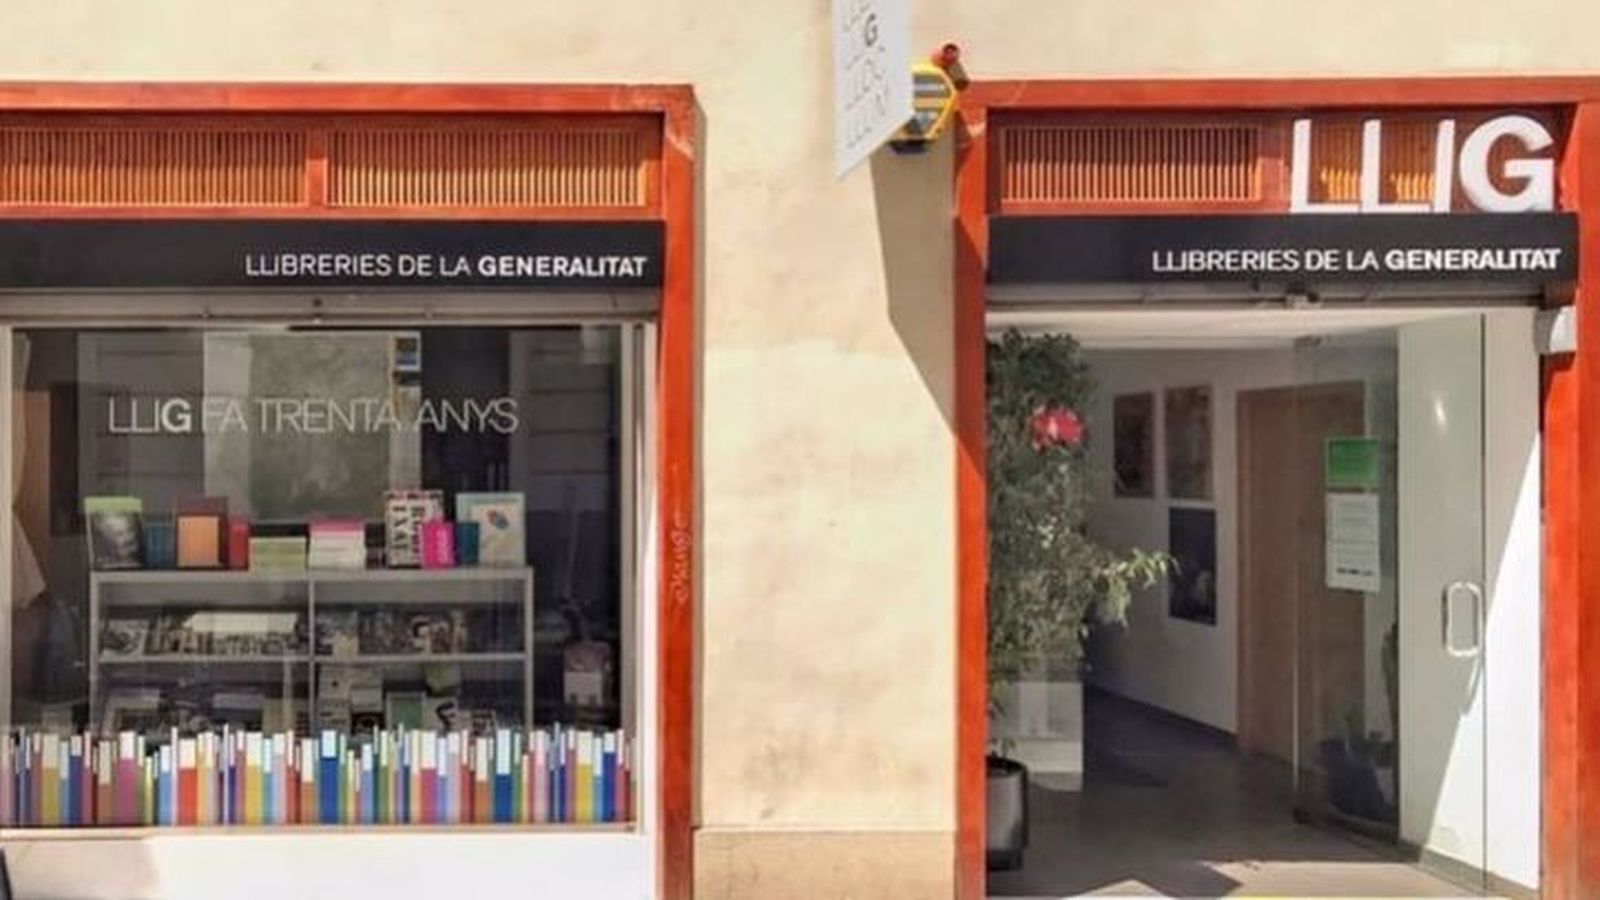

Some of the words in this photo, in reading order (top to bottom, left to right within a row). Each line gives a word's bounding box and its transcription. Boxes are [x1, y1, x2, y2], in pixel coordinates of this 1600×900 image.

[1289, 115, 1555, 213] LLIG
[245, 253, 393, 277] LLIBRERIES
[398, 254, 432, 277] DE
[439, 256, 471, 276] LA
[477, 255, 647, 277] GENERALITAT
[1152, 249, 1301, 272] LLIBRERIES
[1304, 248, 1340, 271] DE
[1346, 249, 1380, 271] LA
[1383, 247, 1562, 271] GENERALITAT
[109, 398, 192, 433] LLIG
[202, 398, 248, 433] FA
[255, 398, 401, 434] TRENTA
[414, 398, 519, 434] ANYS
